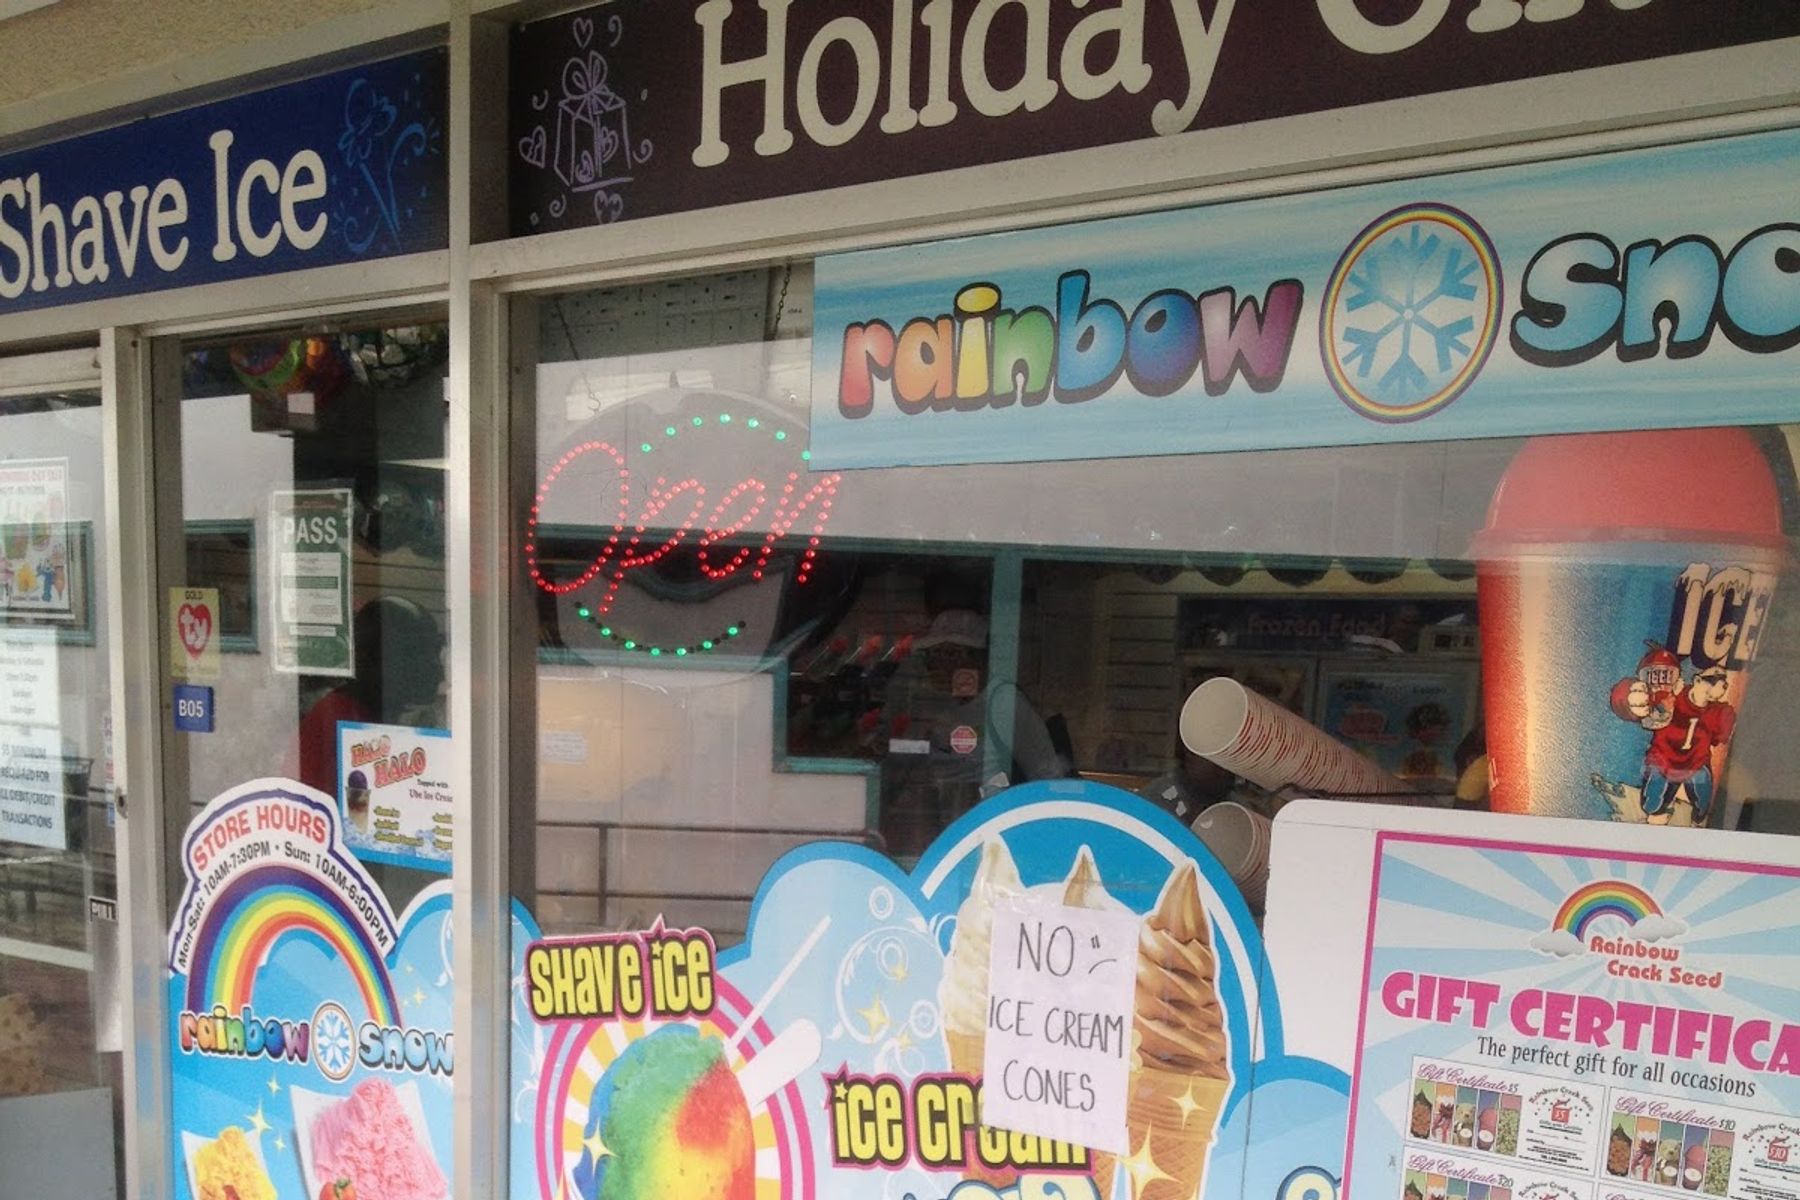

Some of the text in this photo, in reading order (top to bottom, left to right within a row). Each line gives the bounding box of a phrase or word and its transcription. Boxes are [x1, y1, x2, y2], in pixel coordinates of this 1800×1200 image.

[690, 0, 1232, 137] Holiday
[0, 129, 329, 299] Shave Ice
[836, 268, 1304, 421] rainbow
[283, 515, 338, 545] PASS
[527, 439, 842, 614] Open
[178, 699, 204, 718] B05
[373, 746, 427, 788] HALO
[193, 803, 326, 871] STORE HOURS
[284, 840, 311, 863] Sun:
[315, 853, 389, 947] 10AM-6:00PM
[1017, 922, 1076, 977] NO
[1590, 936, 1680, 962] Rainbow
[1607, 960, 1723, 989] Crack Seed
[988, 994, 1125, 1060] ICE CREAM
[1381, 971, 1501, 1029] GIFT
[180, 1004, 454, 1077] rainbow snow
[1477, 1035, 1757, 1098] The perfect gift for all occasions
[1002, 1059, 1096, 1112] CONES
